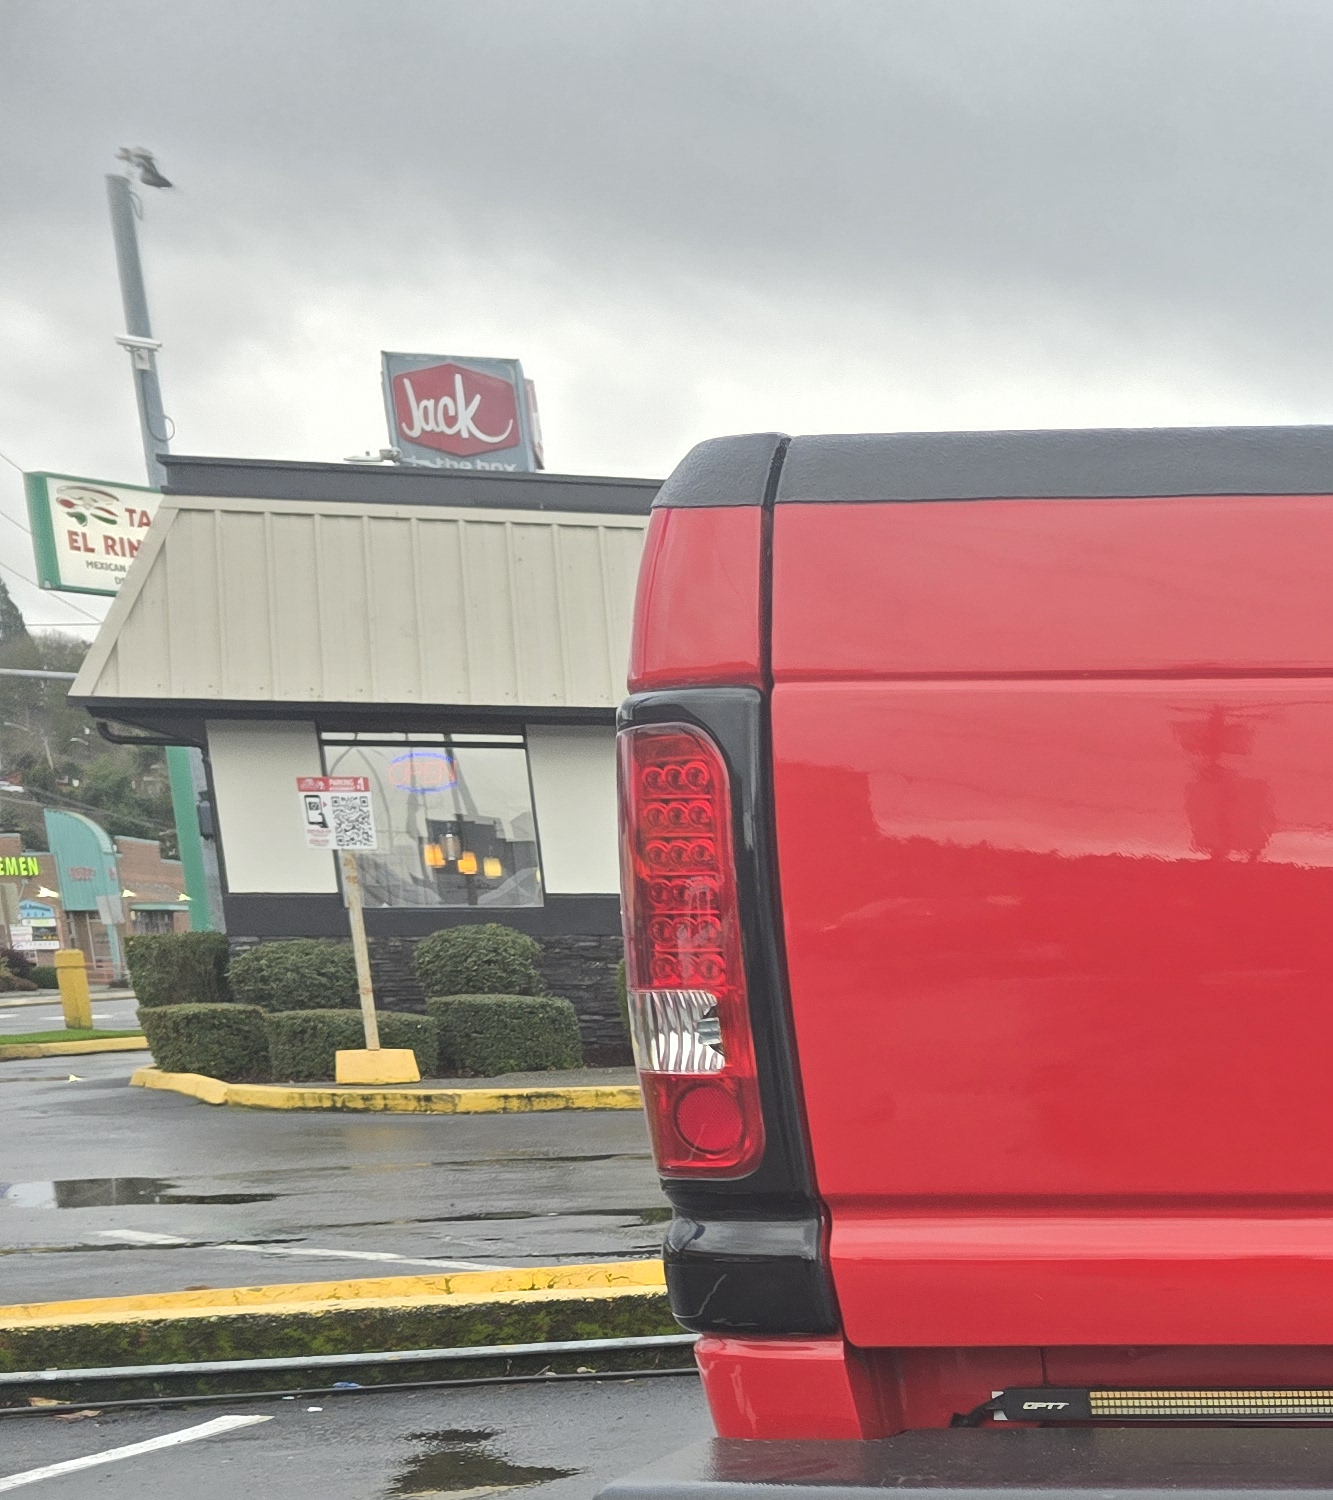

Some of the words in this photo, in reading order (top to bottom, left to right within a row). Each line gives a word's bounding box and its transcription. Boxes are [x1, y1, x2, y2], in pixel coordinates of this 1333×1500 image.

[402, 373, 513, 443] Jack
[67, 530, 96, 553] EL
[86, 560, 127, 573] MEXICAN
